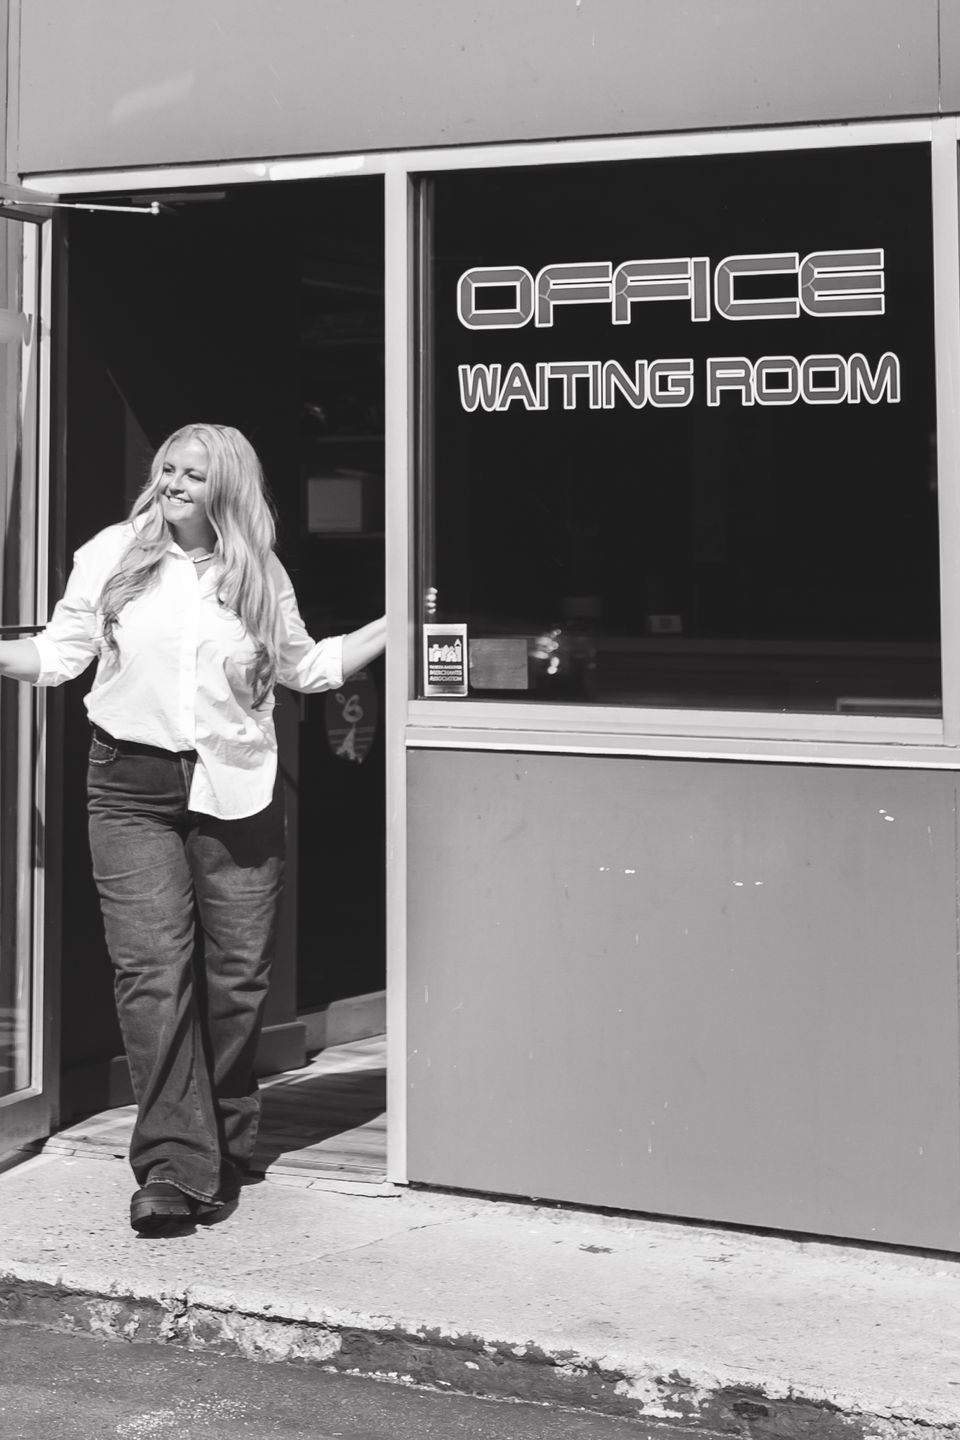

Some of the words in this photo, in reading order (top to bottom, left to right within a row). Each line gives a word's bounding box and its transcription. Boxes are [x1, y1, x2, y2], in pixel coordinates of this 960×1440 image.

[457, 248, 885, 331] OFFICE
[458, 358, 694, 412] WAITING
[707, 352, 901, 407] ROOM
